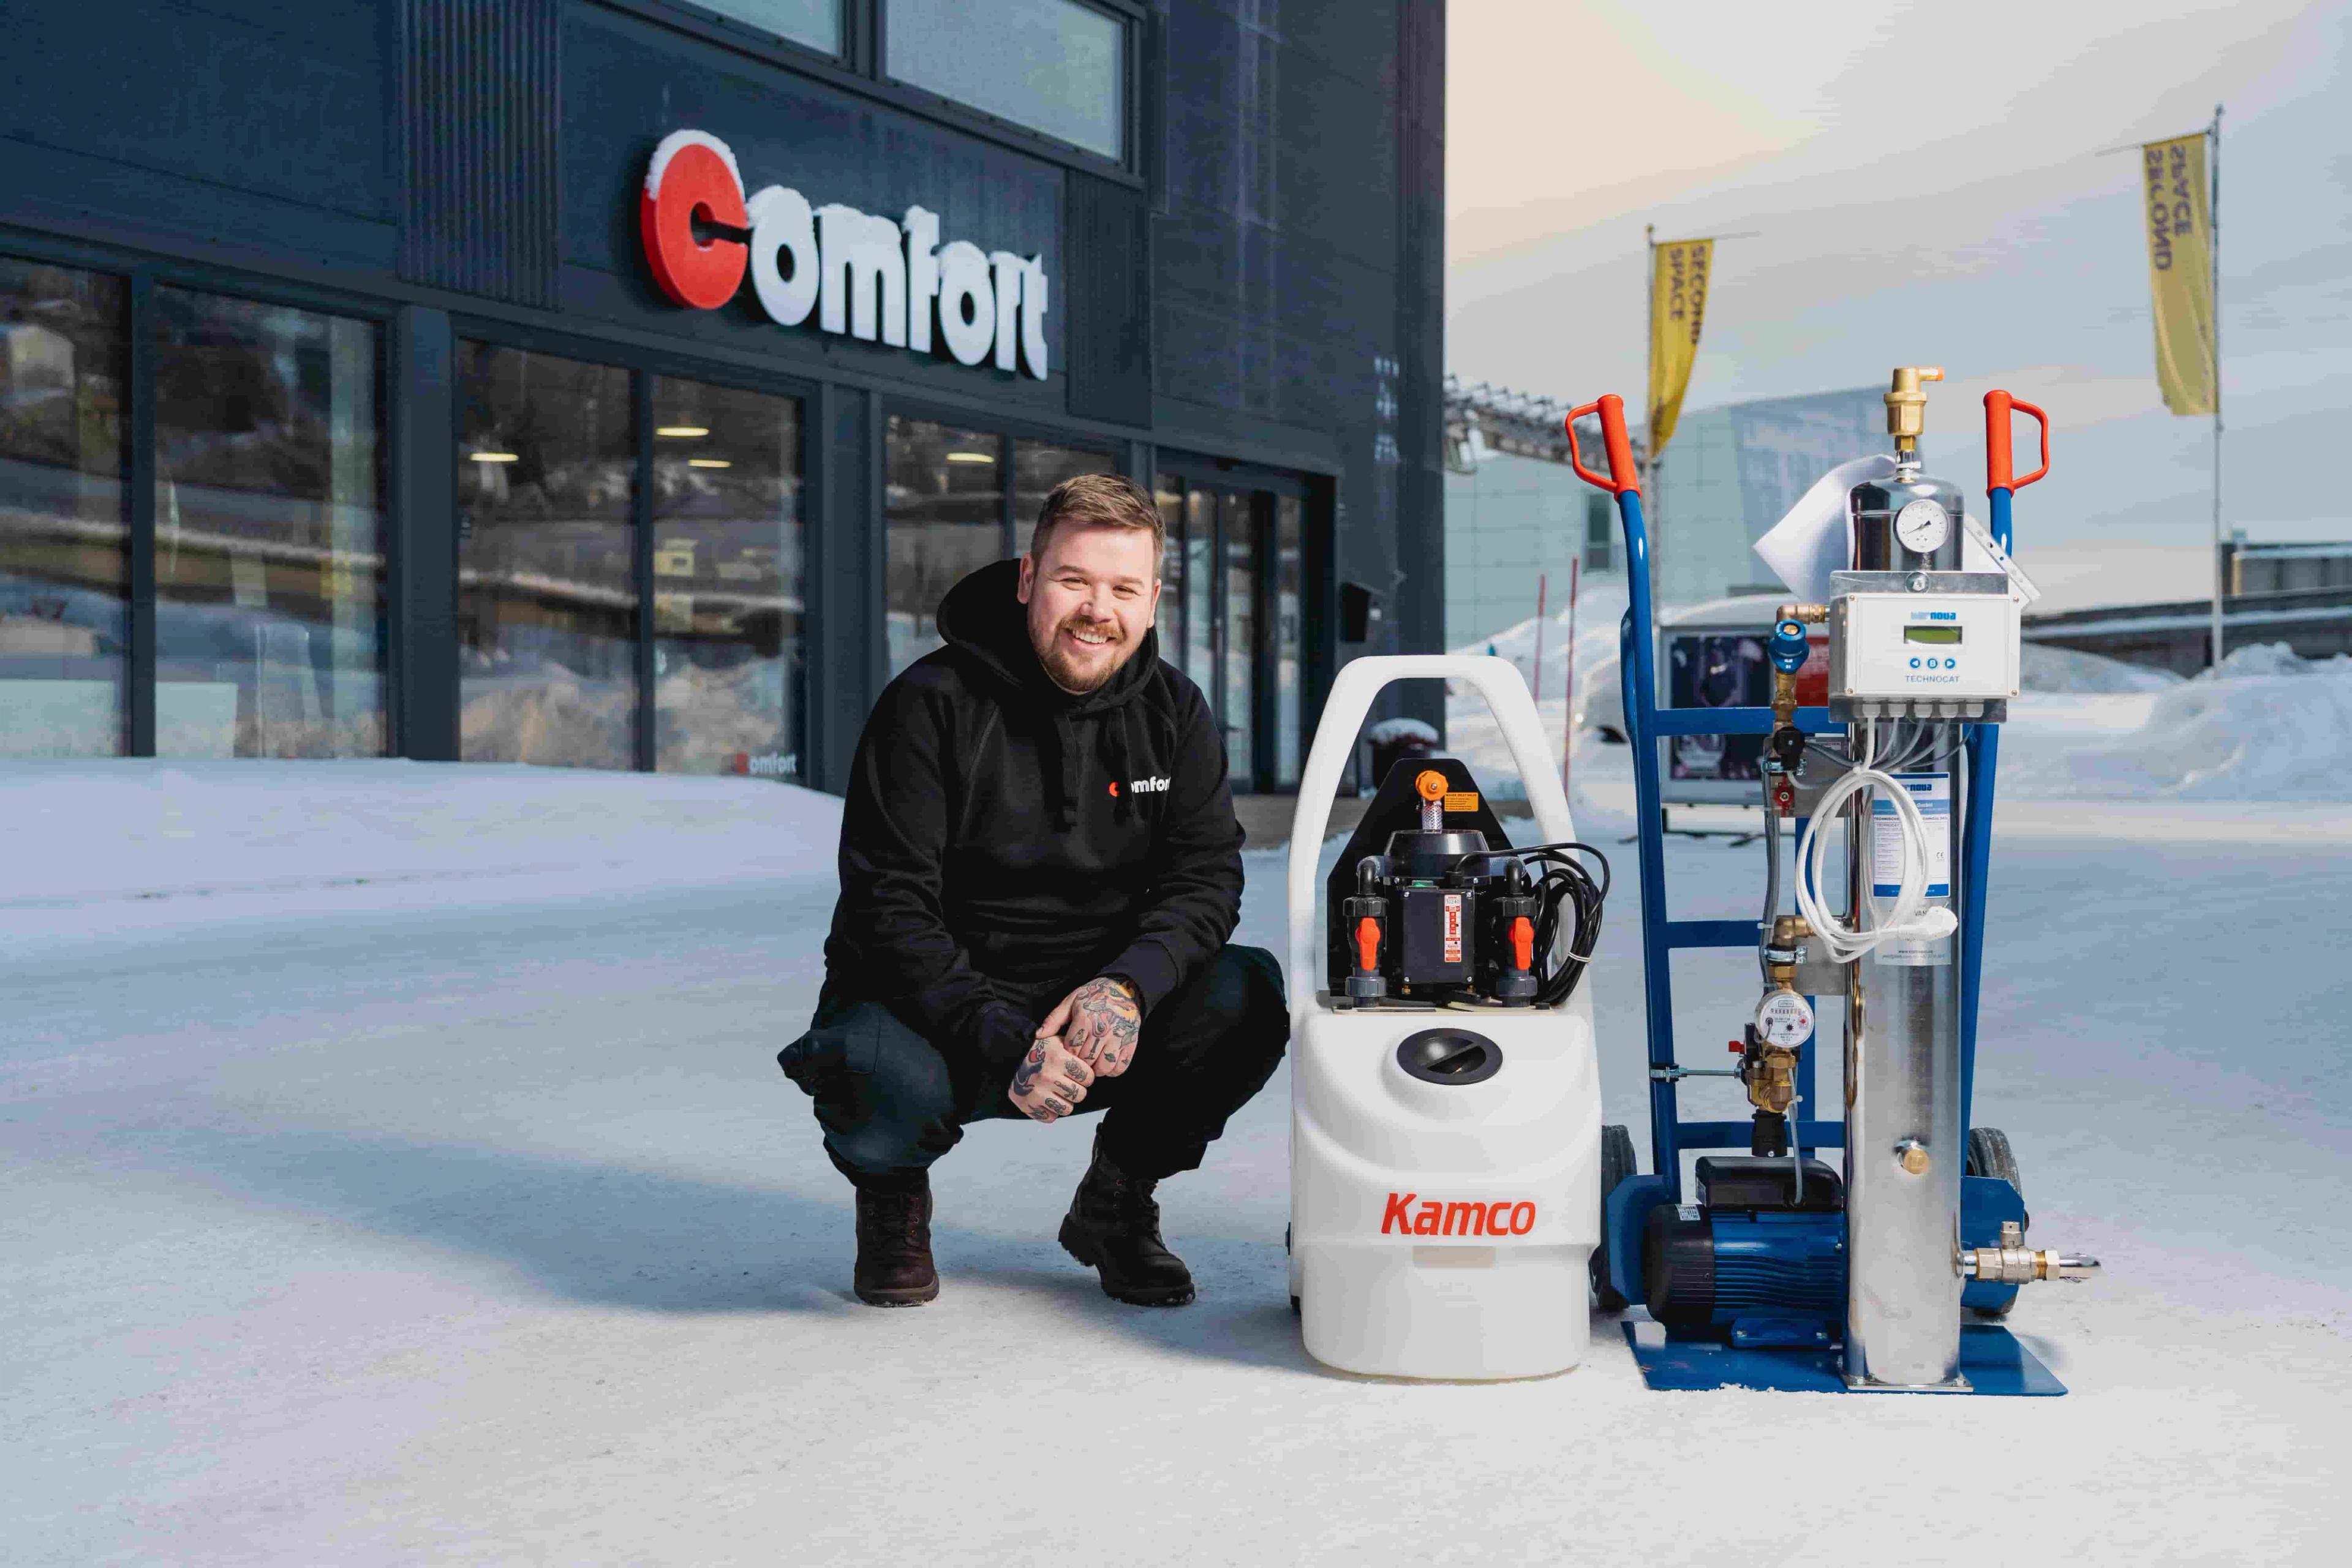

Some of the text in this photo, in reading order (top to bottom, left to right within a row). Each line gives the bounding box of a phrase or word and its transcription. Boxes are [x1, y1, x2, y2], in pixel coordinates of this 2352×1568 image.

[641, 129, 1048, 381] Comfort
[1108, 775, 1171, 797] Cmfor
[1381, 1193, 1536, 1236] Kamco
